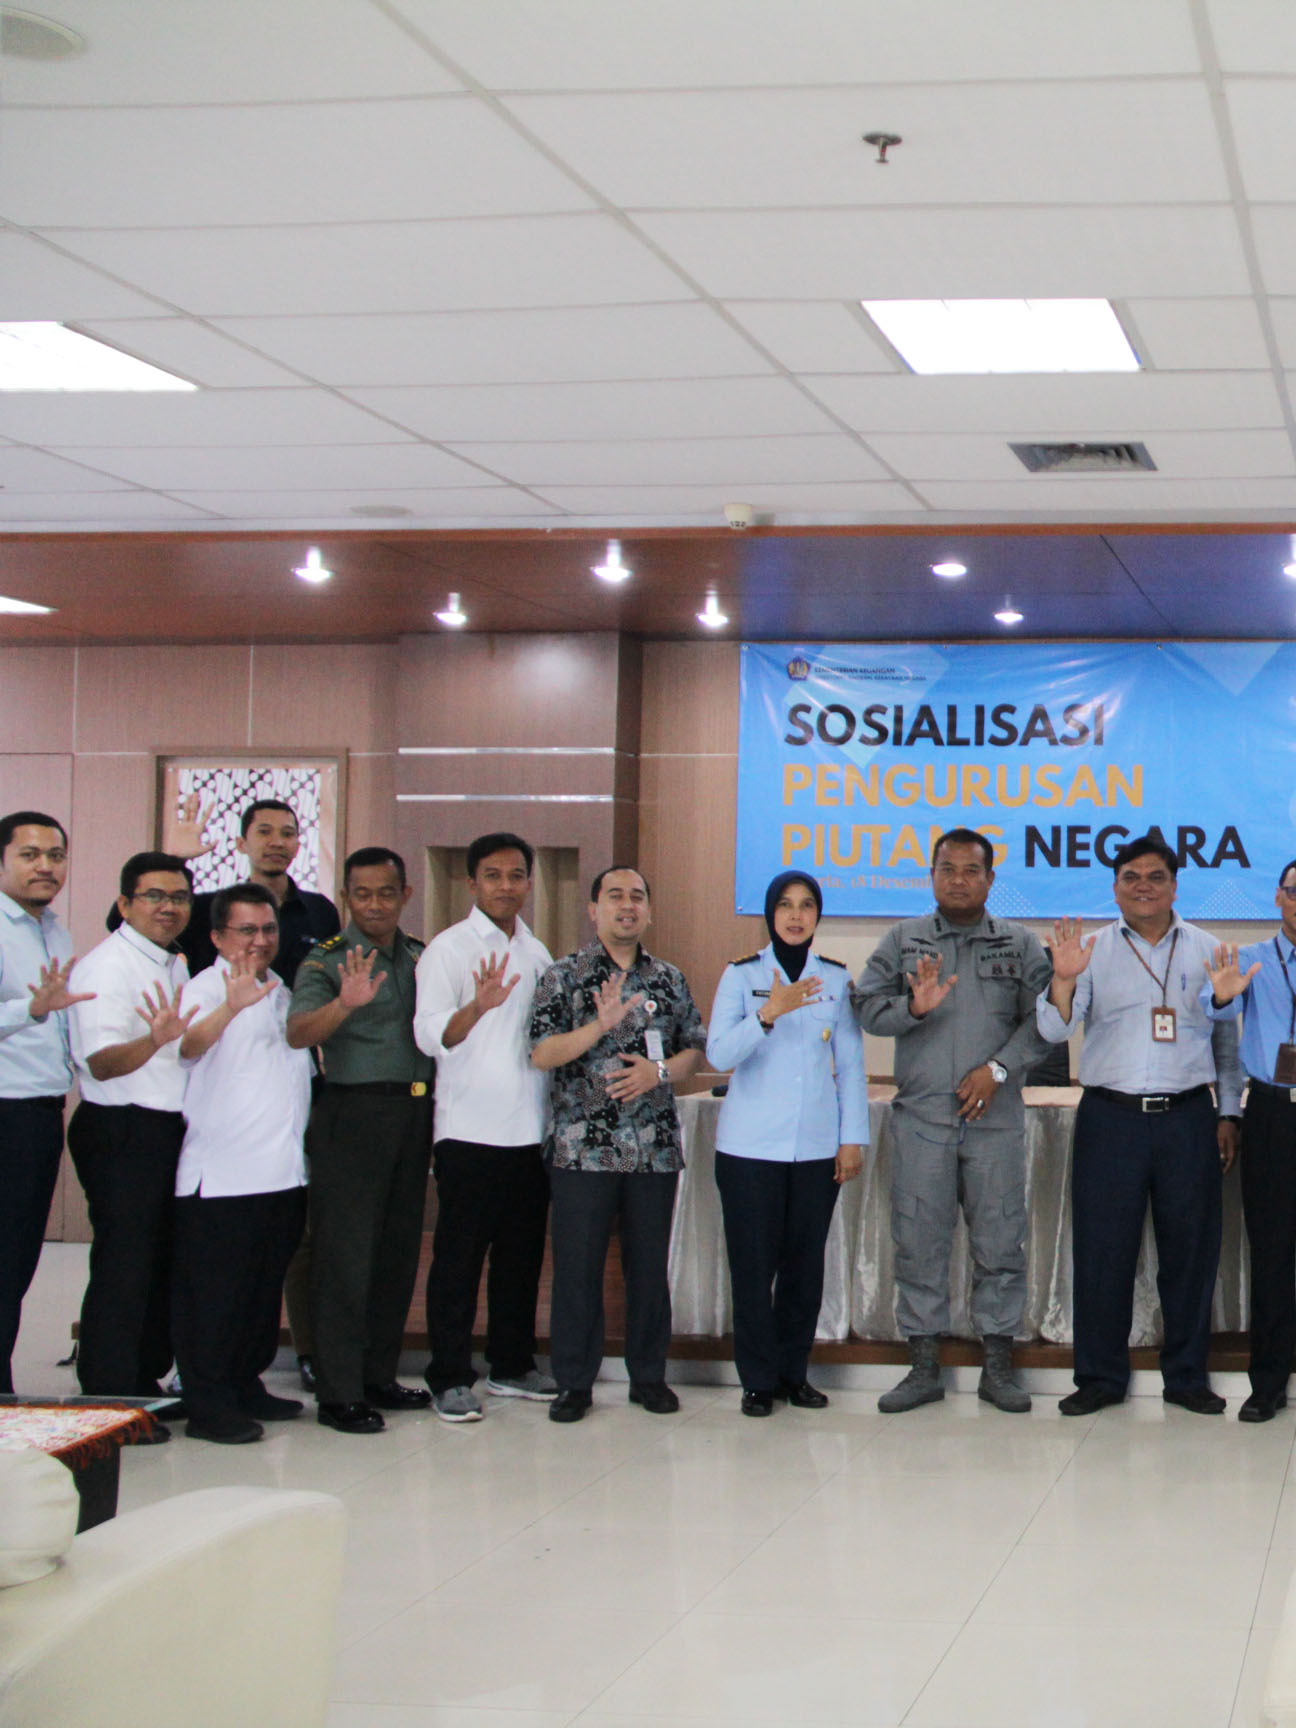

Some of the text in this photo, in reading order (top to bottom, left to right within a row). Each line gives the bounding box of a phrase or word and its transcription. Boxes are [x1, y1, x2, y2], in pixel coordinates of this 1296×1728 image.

[784, 702, 1104, 747] SOSIALISASI
[783, 763, 1143, 807] PENGURUSAN
[782, 823, 1008, 868] PIUTAG
